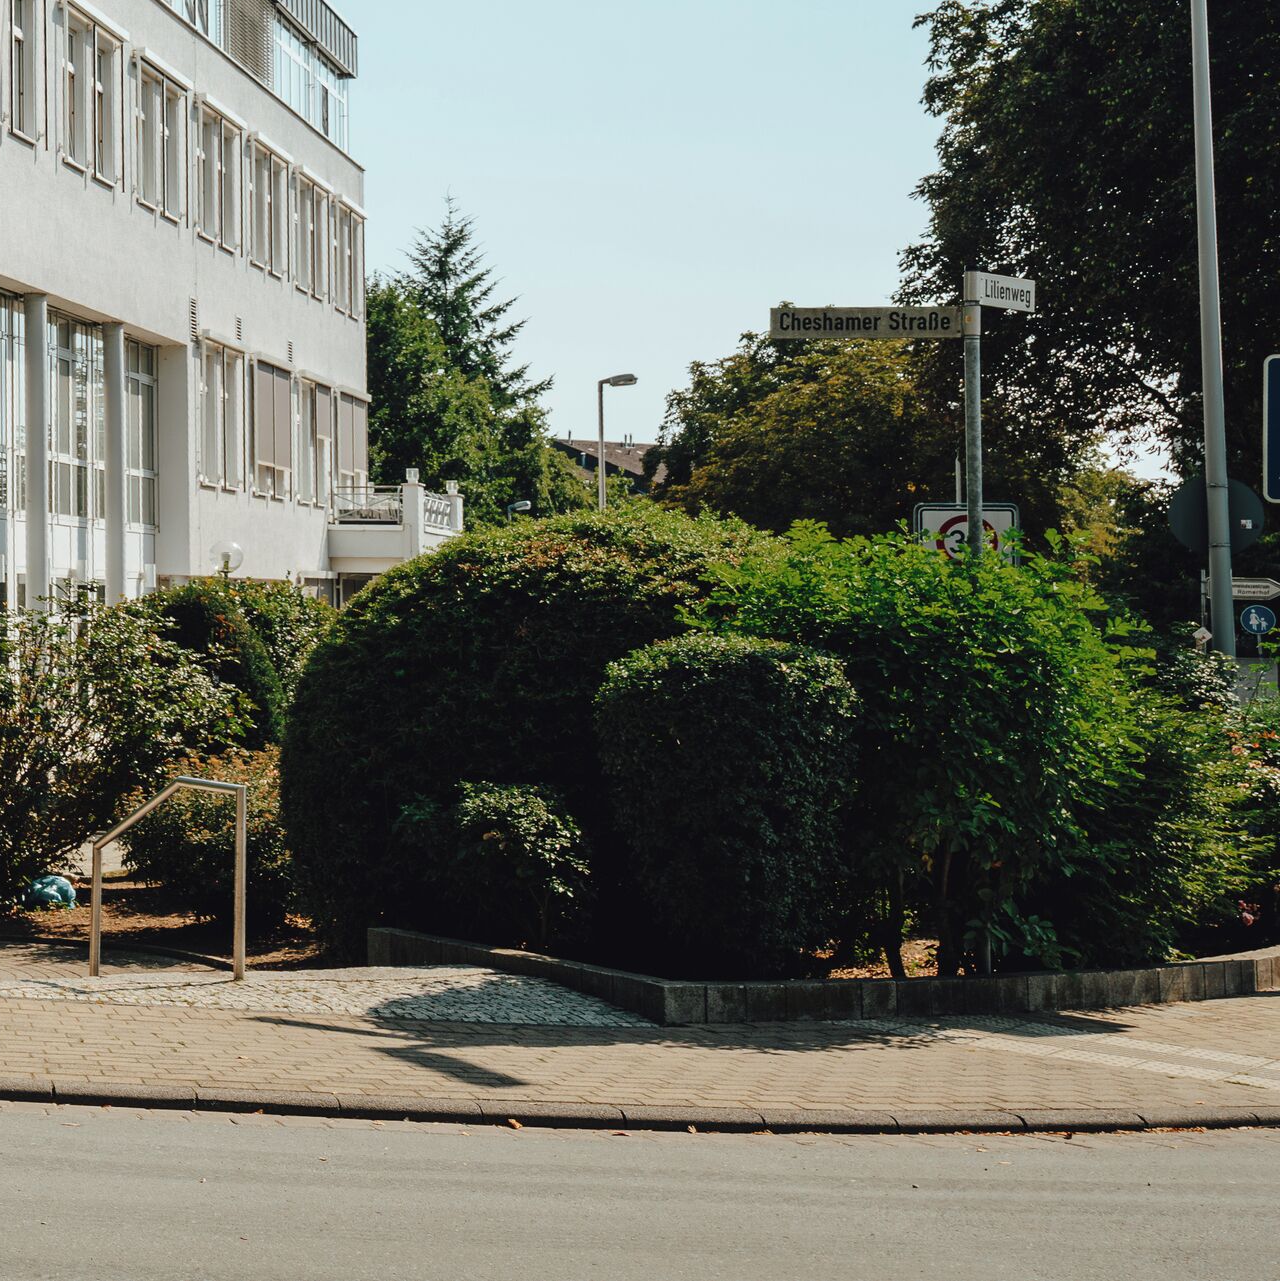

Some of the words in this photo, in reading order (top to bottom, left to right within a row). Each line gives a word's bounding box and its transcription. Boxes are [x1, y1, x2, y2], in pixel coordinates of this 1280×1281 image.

[985, 278, 1032, 309] Lilienweg
[779, 312, 882, 332] Cheshamer
[889, 311, 951, 332] Straße
